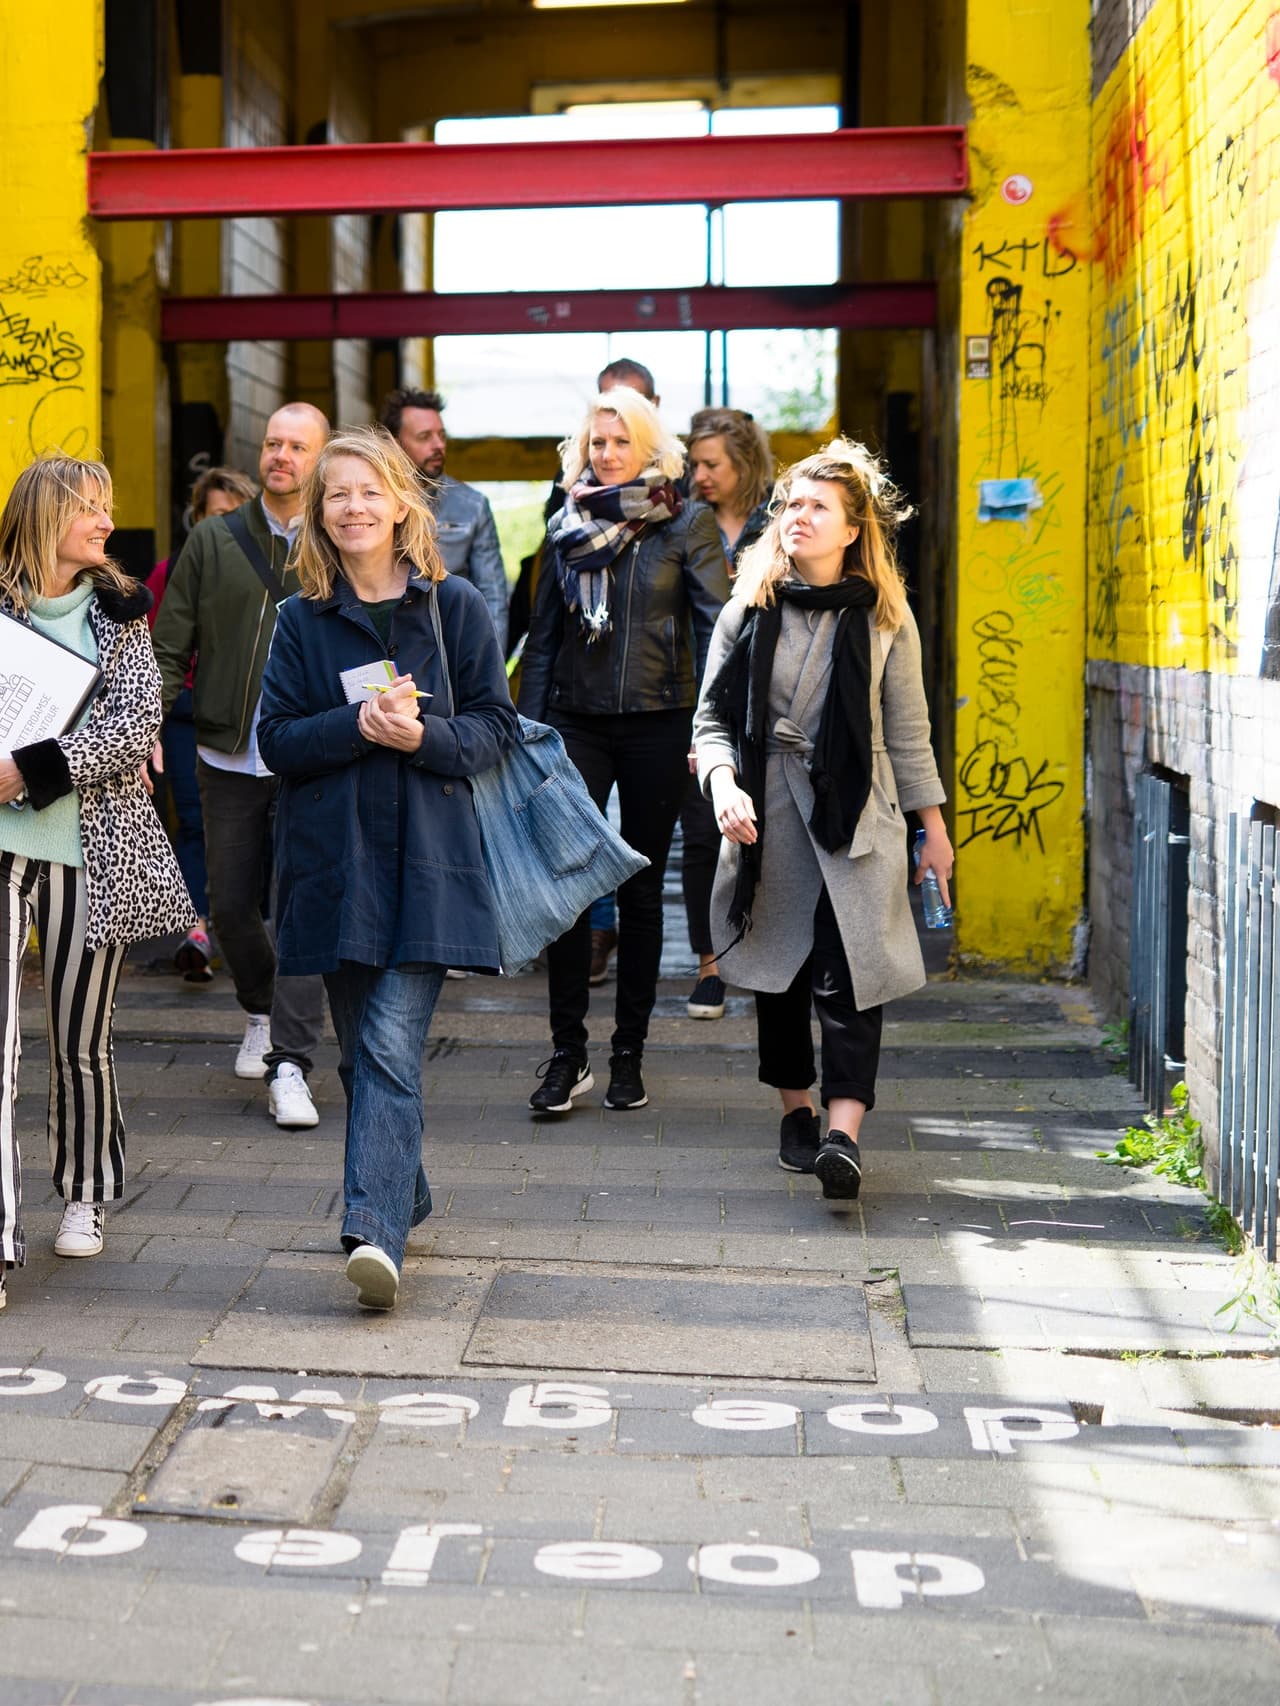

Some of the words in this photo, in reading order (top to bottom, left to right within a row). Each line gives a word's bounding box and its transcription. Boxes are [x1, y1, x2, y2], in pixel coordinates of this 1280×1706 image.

[691, 1398, 1080, 1454] doe
[233, 1522, 484, 1587] je
[533, 1539, 986, 1608] doe
